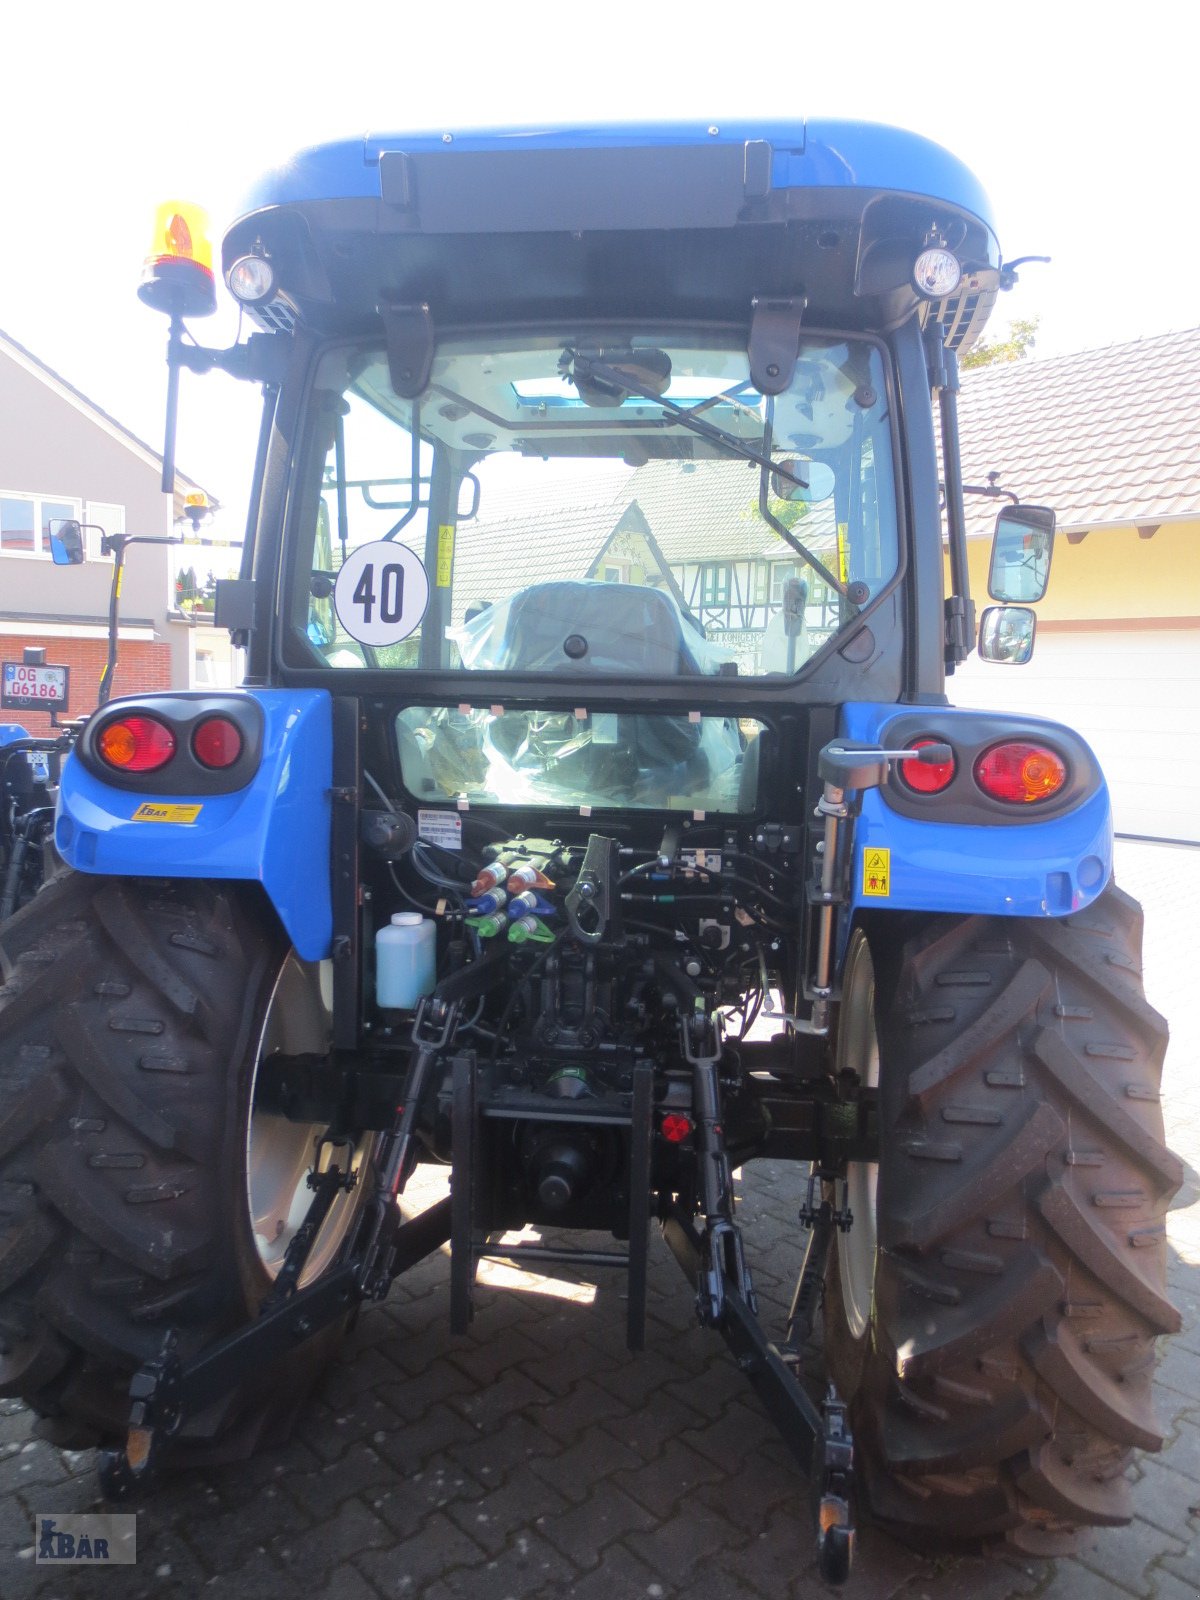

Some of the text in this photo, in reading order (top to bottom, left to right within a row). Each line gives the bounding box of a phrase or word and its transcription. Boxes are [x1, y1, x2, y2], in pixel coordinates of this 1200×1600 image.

[352, 563, 405, 624] 40
[17, 667, 37, 682] OG
[12, 681, 57, 698] 06186
